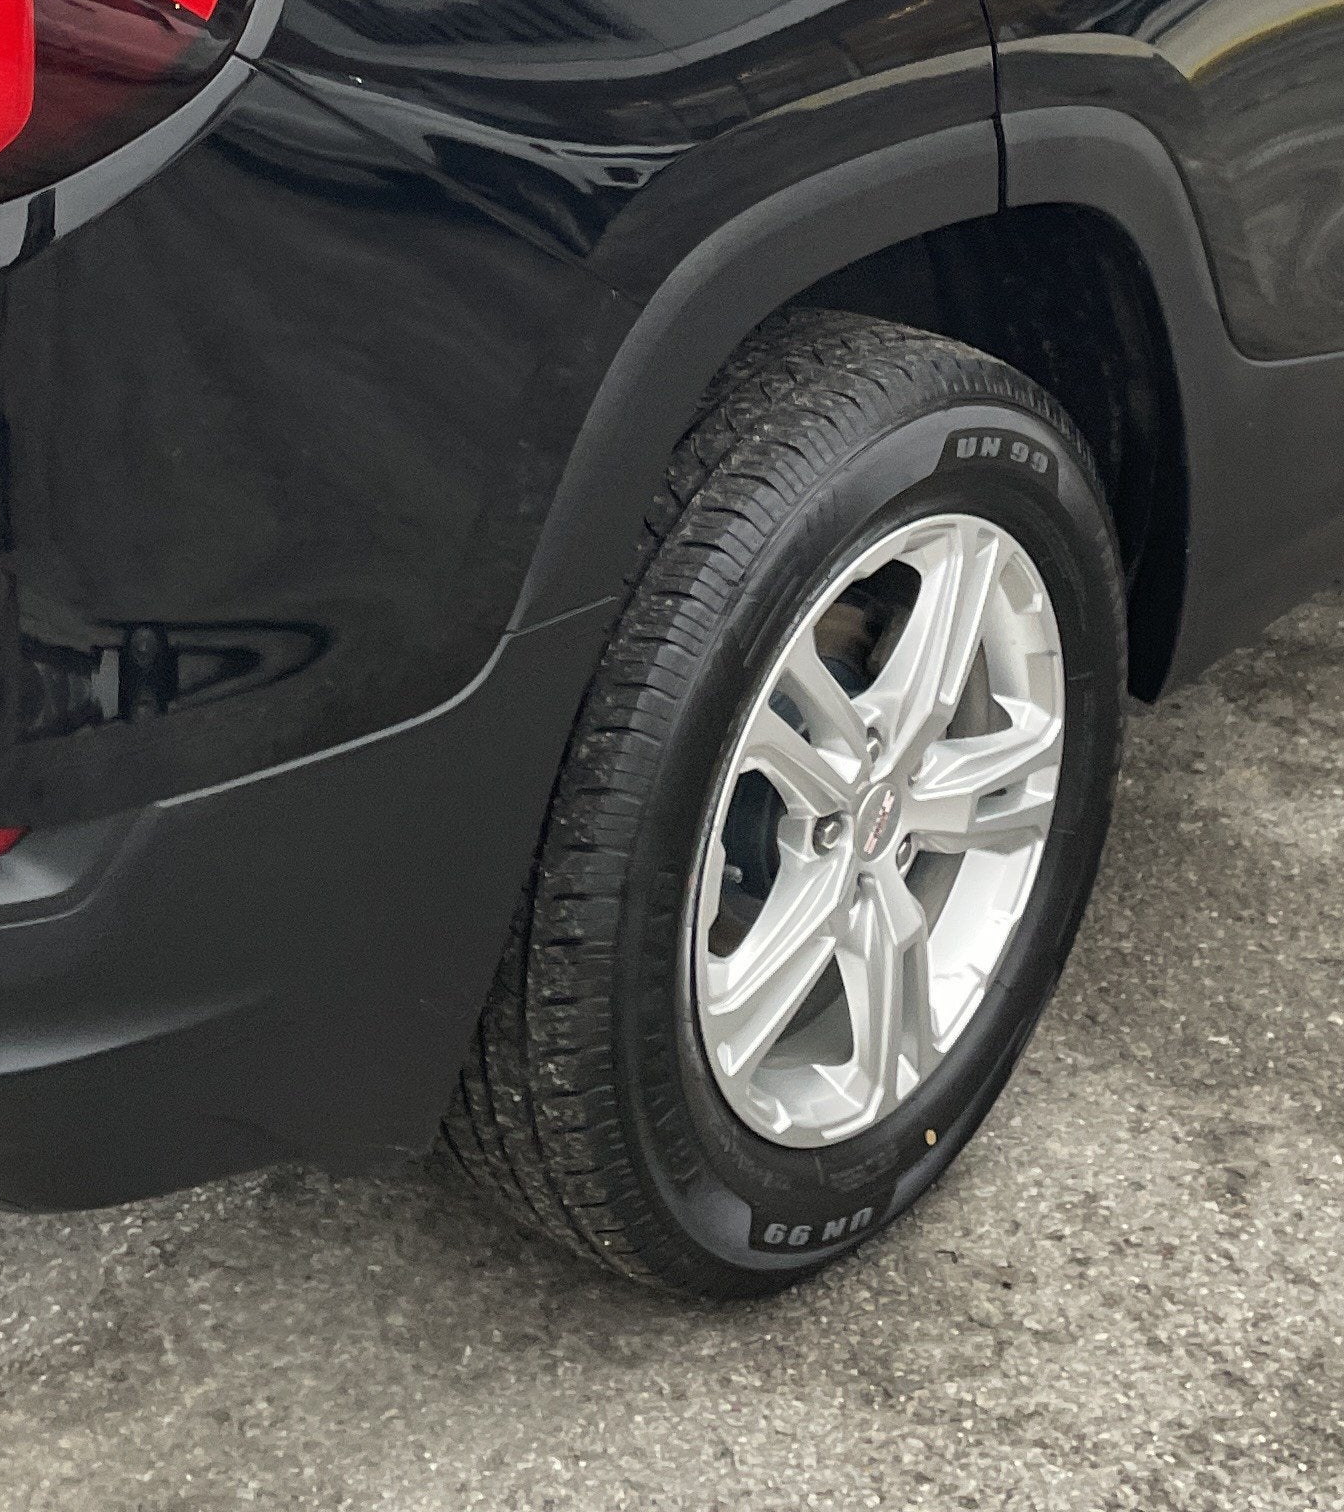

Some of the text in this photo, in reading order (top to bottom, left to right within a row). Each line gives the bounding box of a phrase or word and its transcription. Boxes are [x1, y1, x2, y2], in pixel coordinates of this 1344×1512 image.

[957, 436, 1049, 474] UN 99
[763, 1222, 814, 1247] 99
